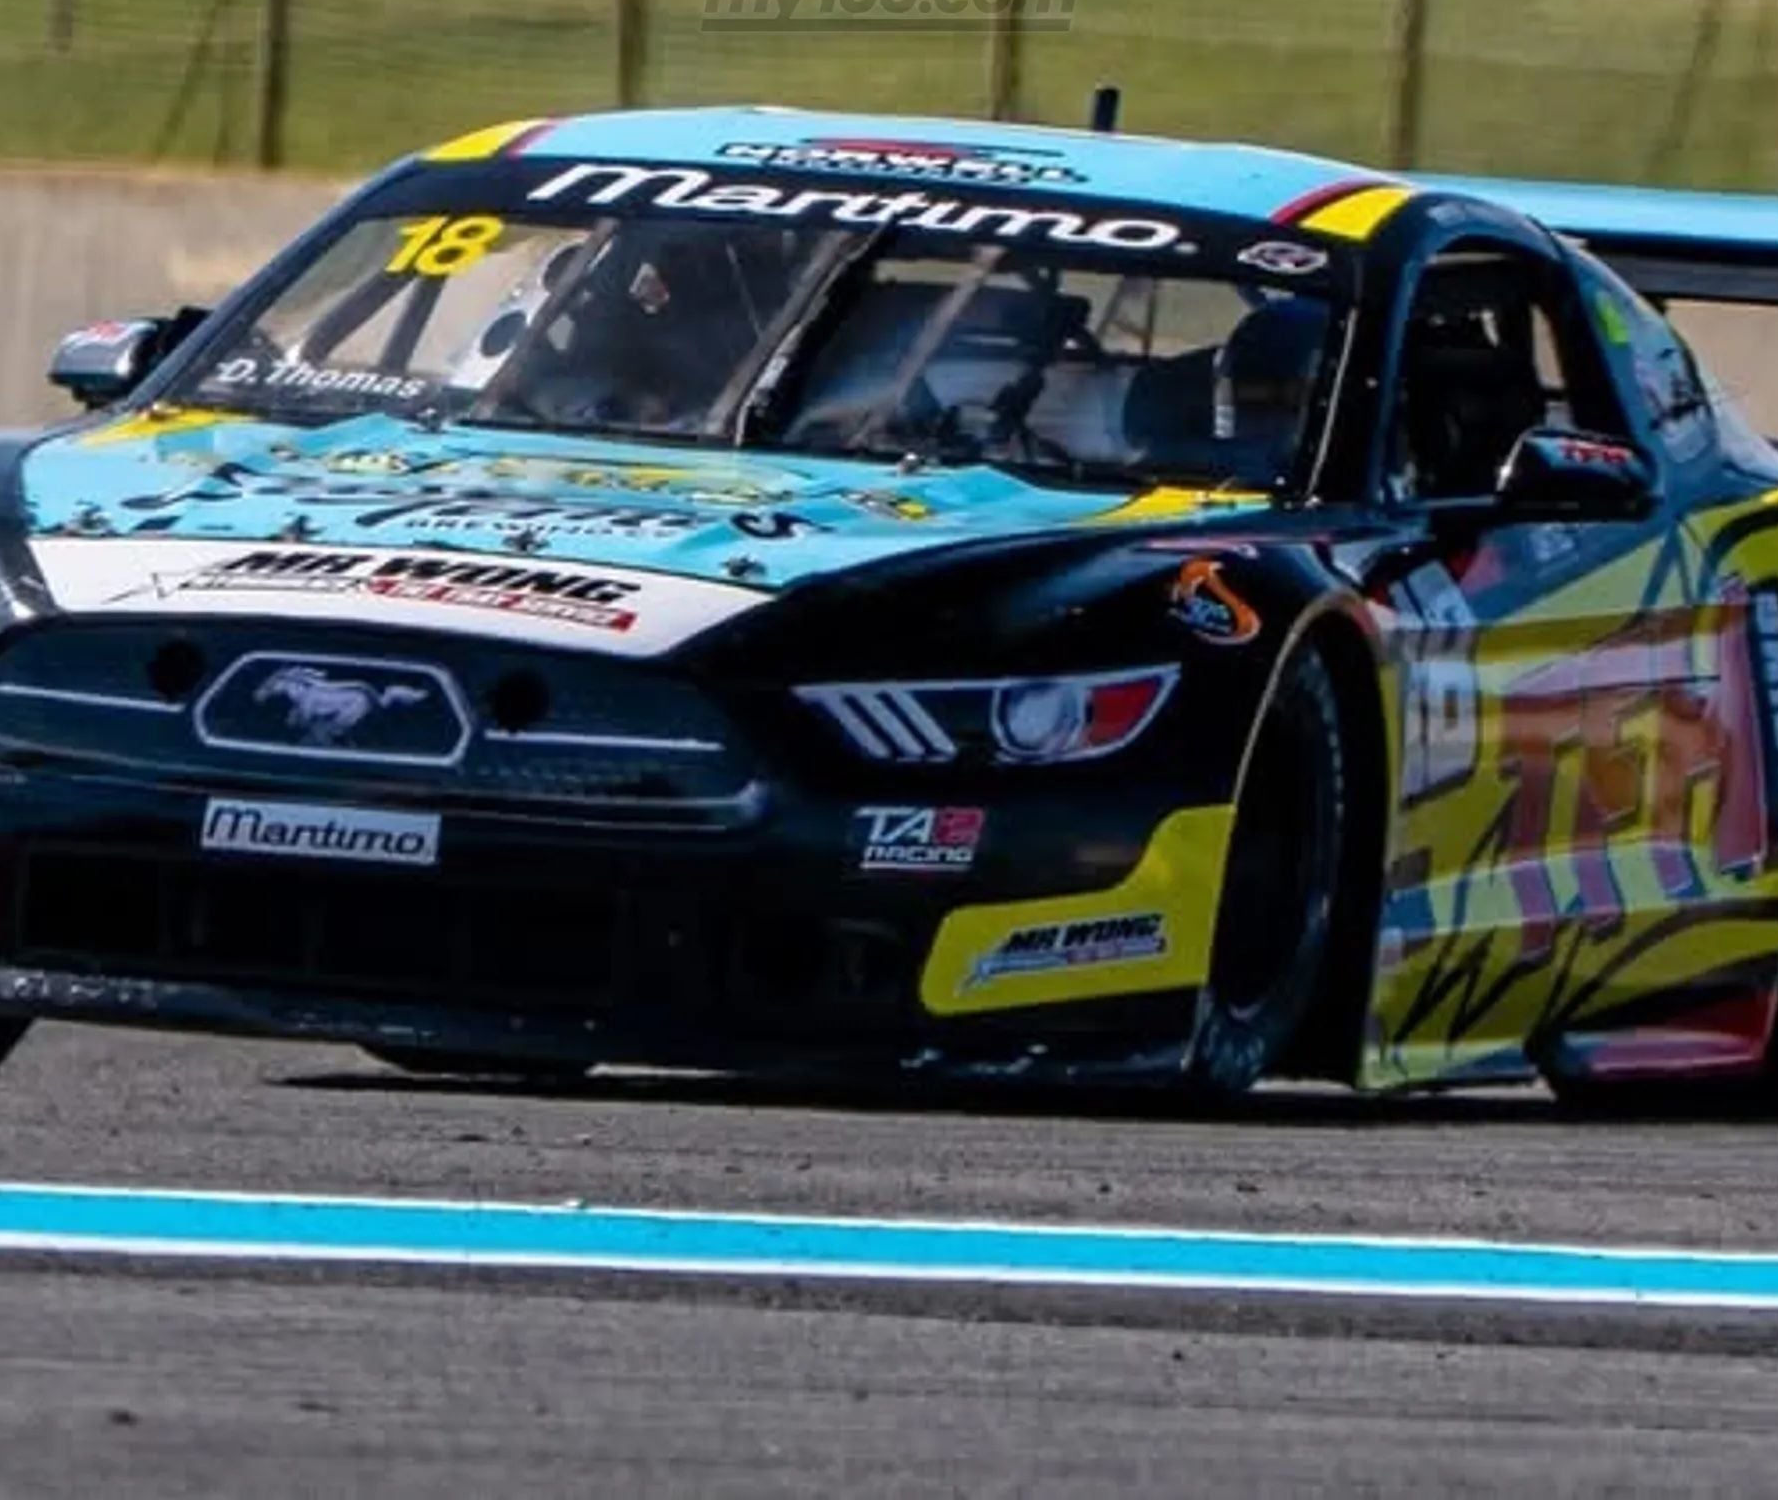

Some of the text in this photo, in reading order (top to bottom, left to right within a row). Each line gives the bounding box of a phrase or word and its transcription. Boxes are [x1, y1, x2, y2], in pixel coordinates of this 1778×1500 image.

[527, 162, 1183, 250] Maritimo
[384, 214, 504, 276] 18
[224, 551, 376, 574] MR
[371, 557, 641, 604] WONG
[207, 806, 427, 855] Maritimo
[854, 806, 985, 844] TA2
[1000, 913, 1164, 953] MR WONG
